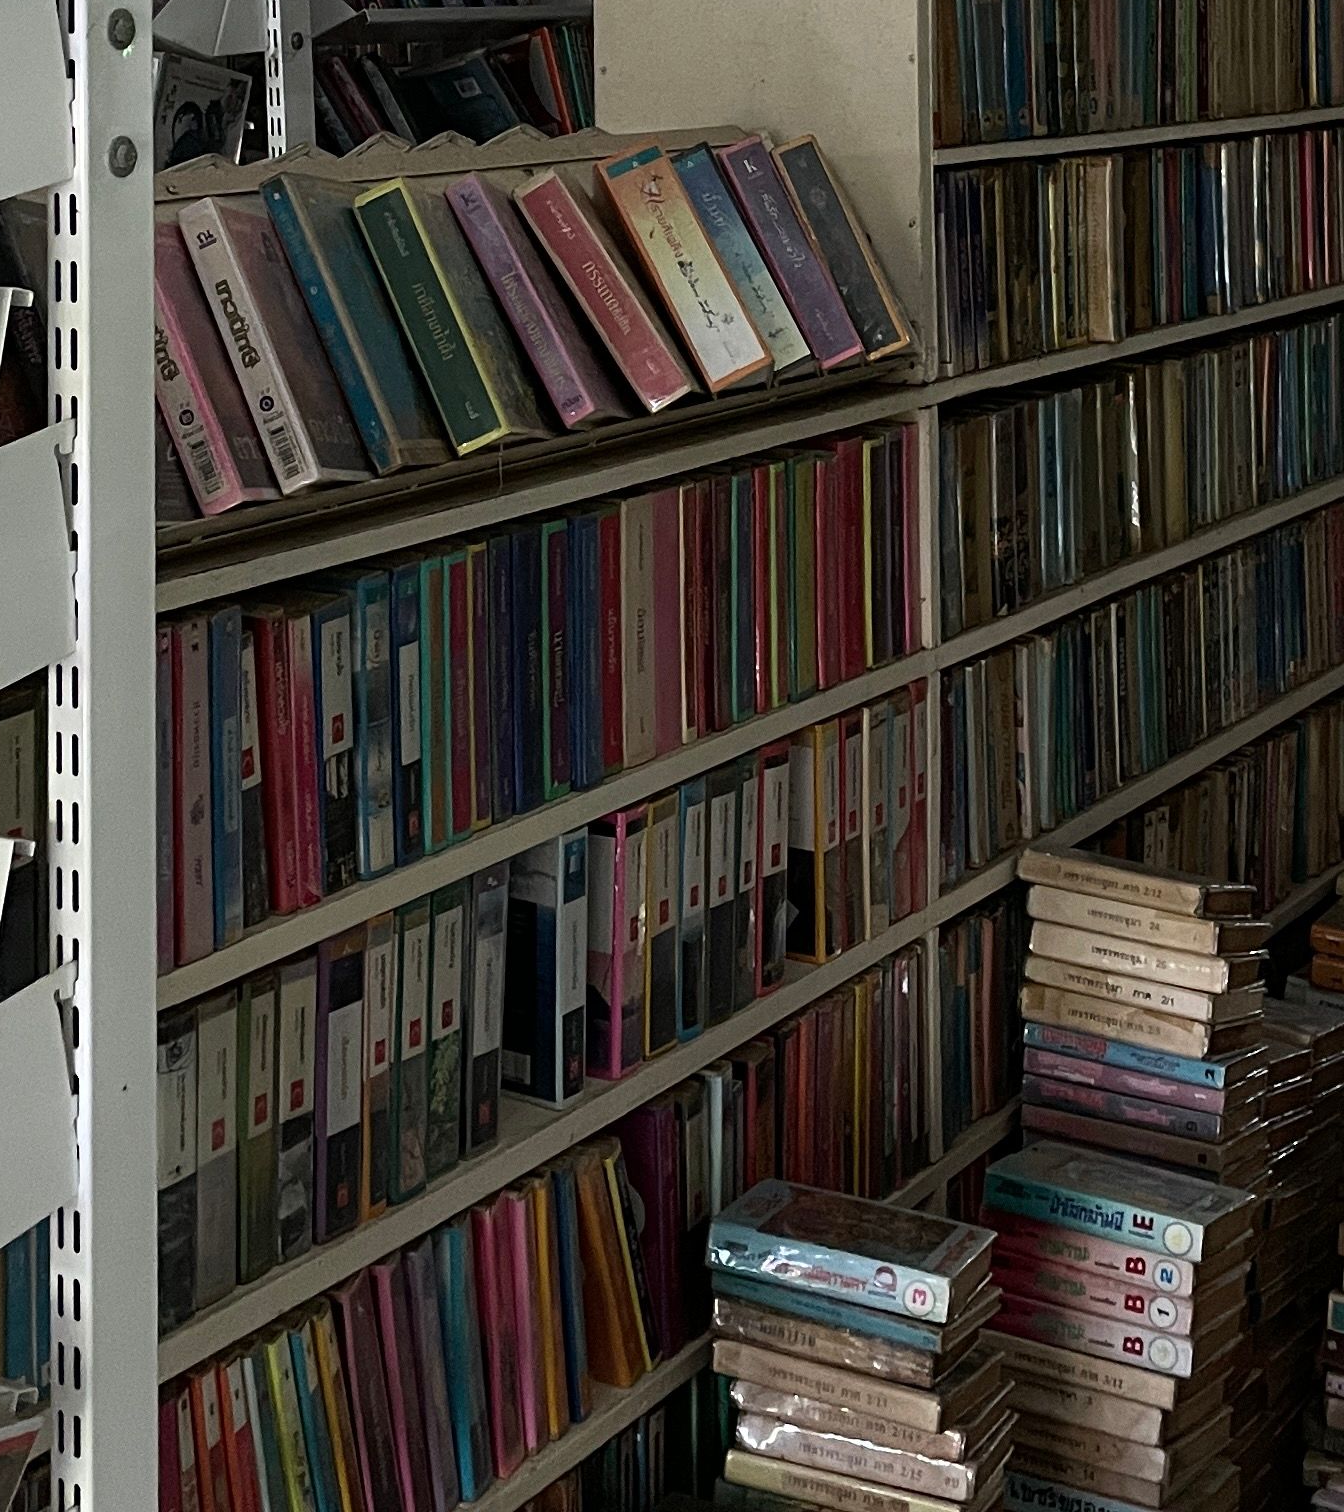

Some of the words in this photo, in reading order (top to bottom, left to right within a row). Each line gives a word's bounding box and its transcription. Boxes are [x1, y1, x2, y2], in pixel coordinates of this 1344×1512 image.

[1125, 1257, 1146, 1276] B
[1160, 1268, 1173, 1284] 2
[1124, 1294, 1145, 1314] B
[1122, 1336, 1144, 1356] B
